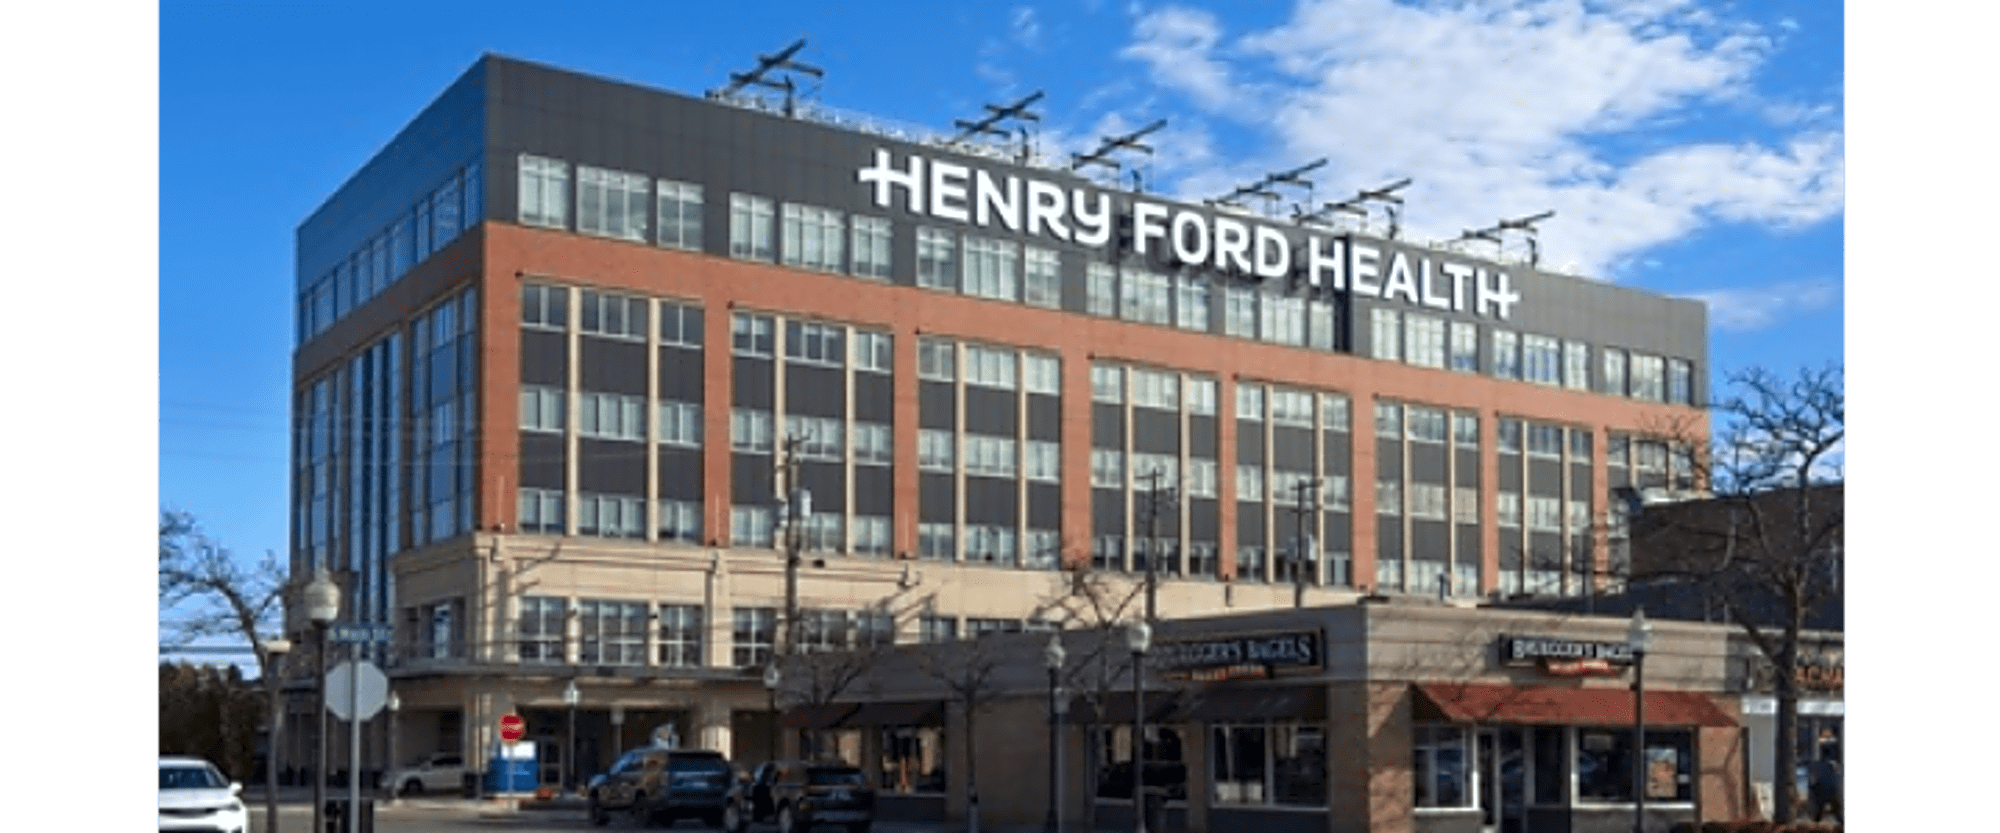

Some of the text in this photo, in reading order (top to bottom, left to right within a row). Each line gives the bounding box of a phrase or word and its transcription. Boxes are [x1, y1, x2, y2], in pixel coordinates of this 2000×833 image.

[858, 148, 1520, 320] HENRY FORD HEALTH
